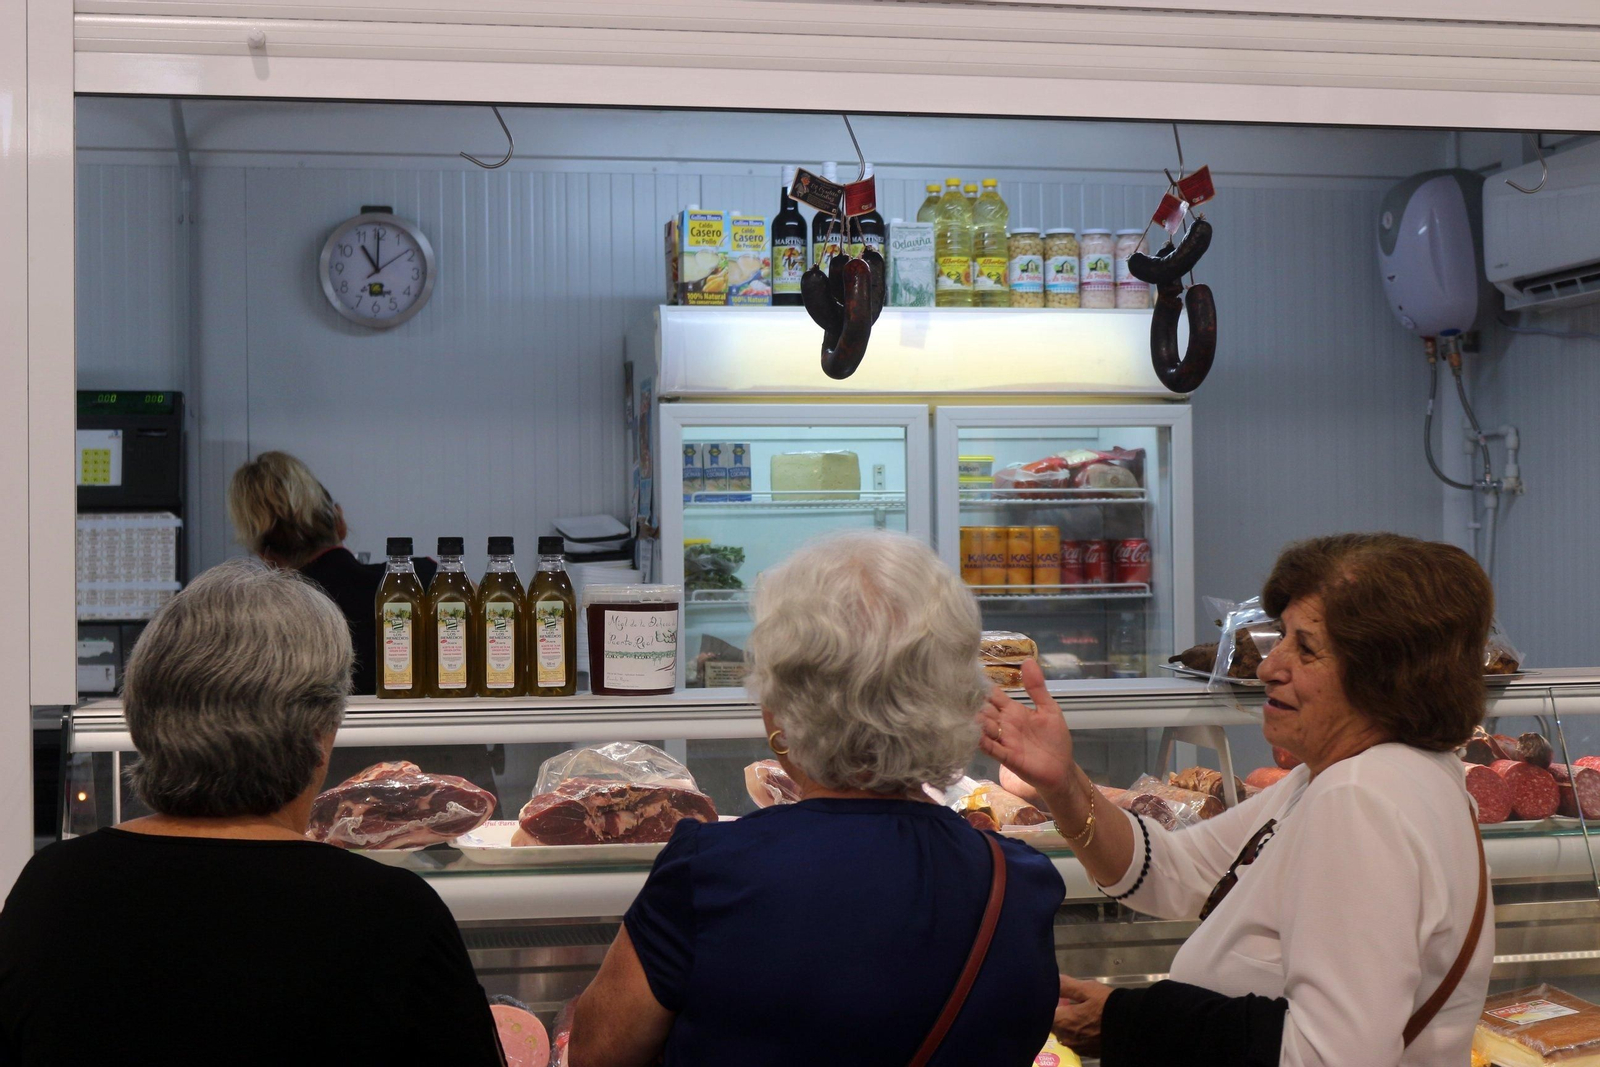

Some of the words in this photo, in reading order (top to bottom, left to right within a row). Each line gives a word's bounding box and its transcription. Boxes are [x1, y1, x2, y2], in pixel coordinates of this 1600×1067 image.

[356, 231, 366, 242] 11
[372, 228, 387, 241] 12
[690, 227, 721, 237] Casero
[733, 233, 763, 242] Casero
[395, 234, 400, 245] 1
[892, 237, 932, 249] Delaviña
[338, 244, 353, 258] 10
[407, 248, 415, 262] 2
[335, 262, 344, 274] 9
[411, 268, 420, 281] 3
[340, 281, 348, 294] 8
[403, 286, 411, 296] 4
[356, 296, 362, 308] 7
[372, 301, 380, 314] 6
[389, 298, 398, 311] 5
[983, 554, 1004, 563] KAS
[1011, 554, 1032, 562] KAS
[1037, 553, 1058, 562] KAS
[608, 615, 627, 631] Miel
[607, 634, 632, 646] Puerto
[633, 636, 653, 649] Real
